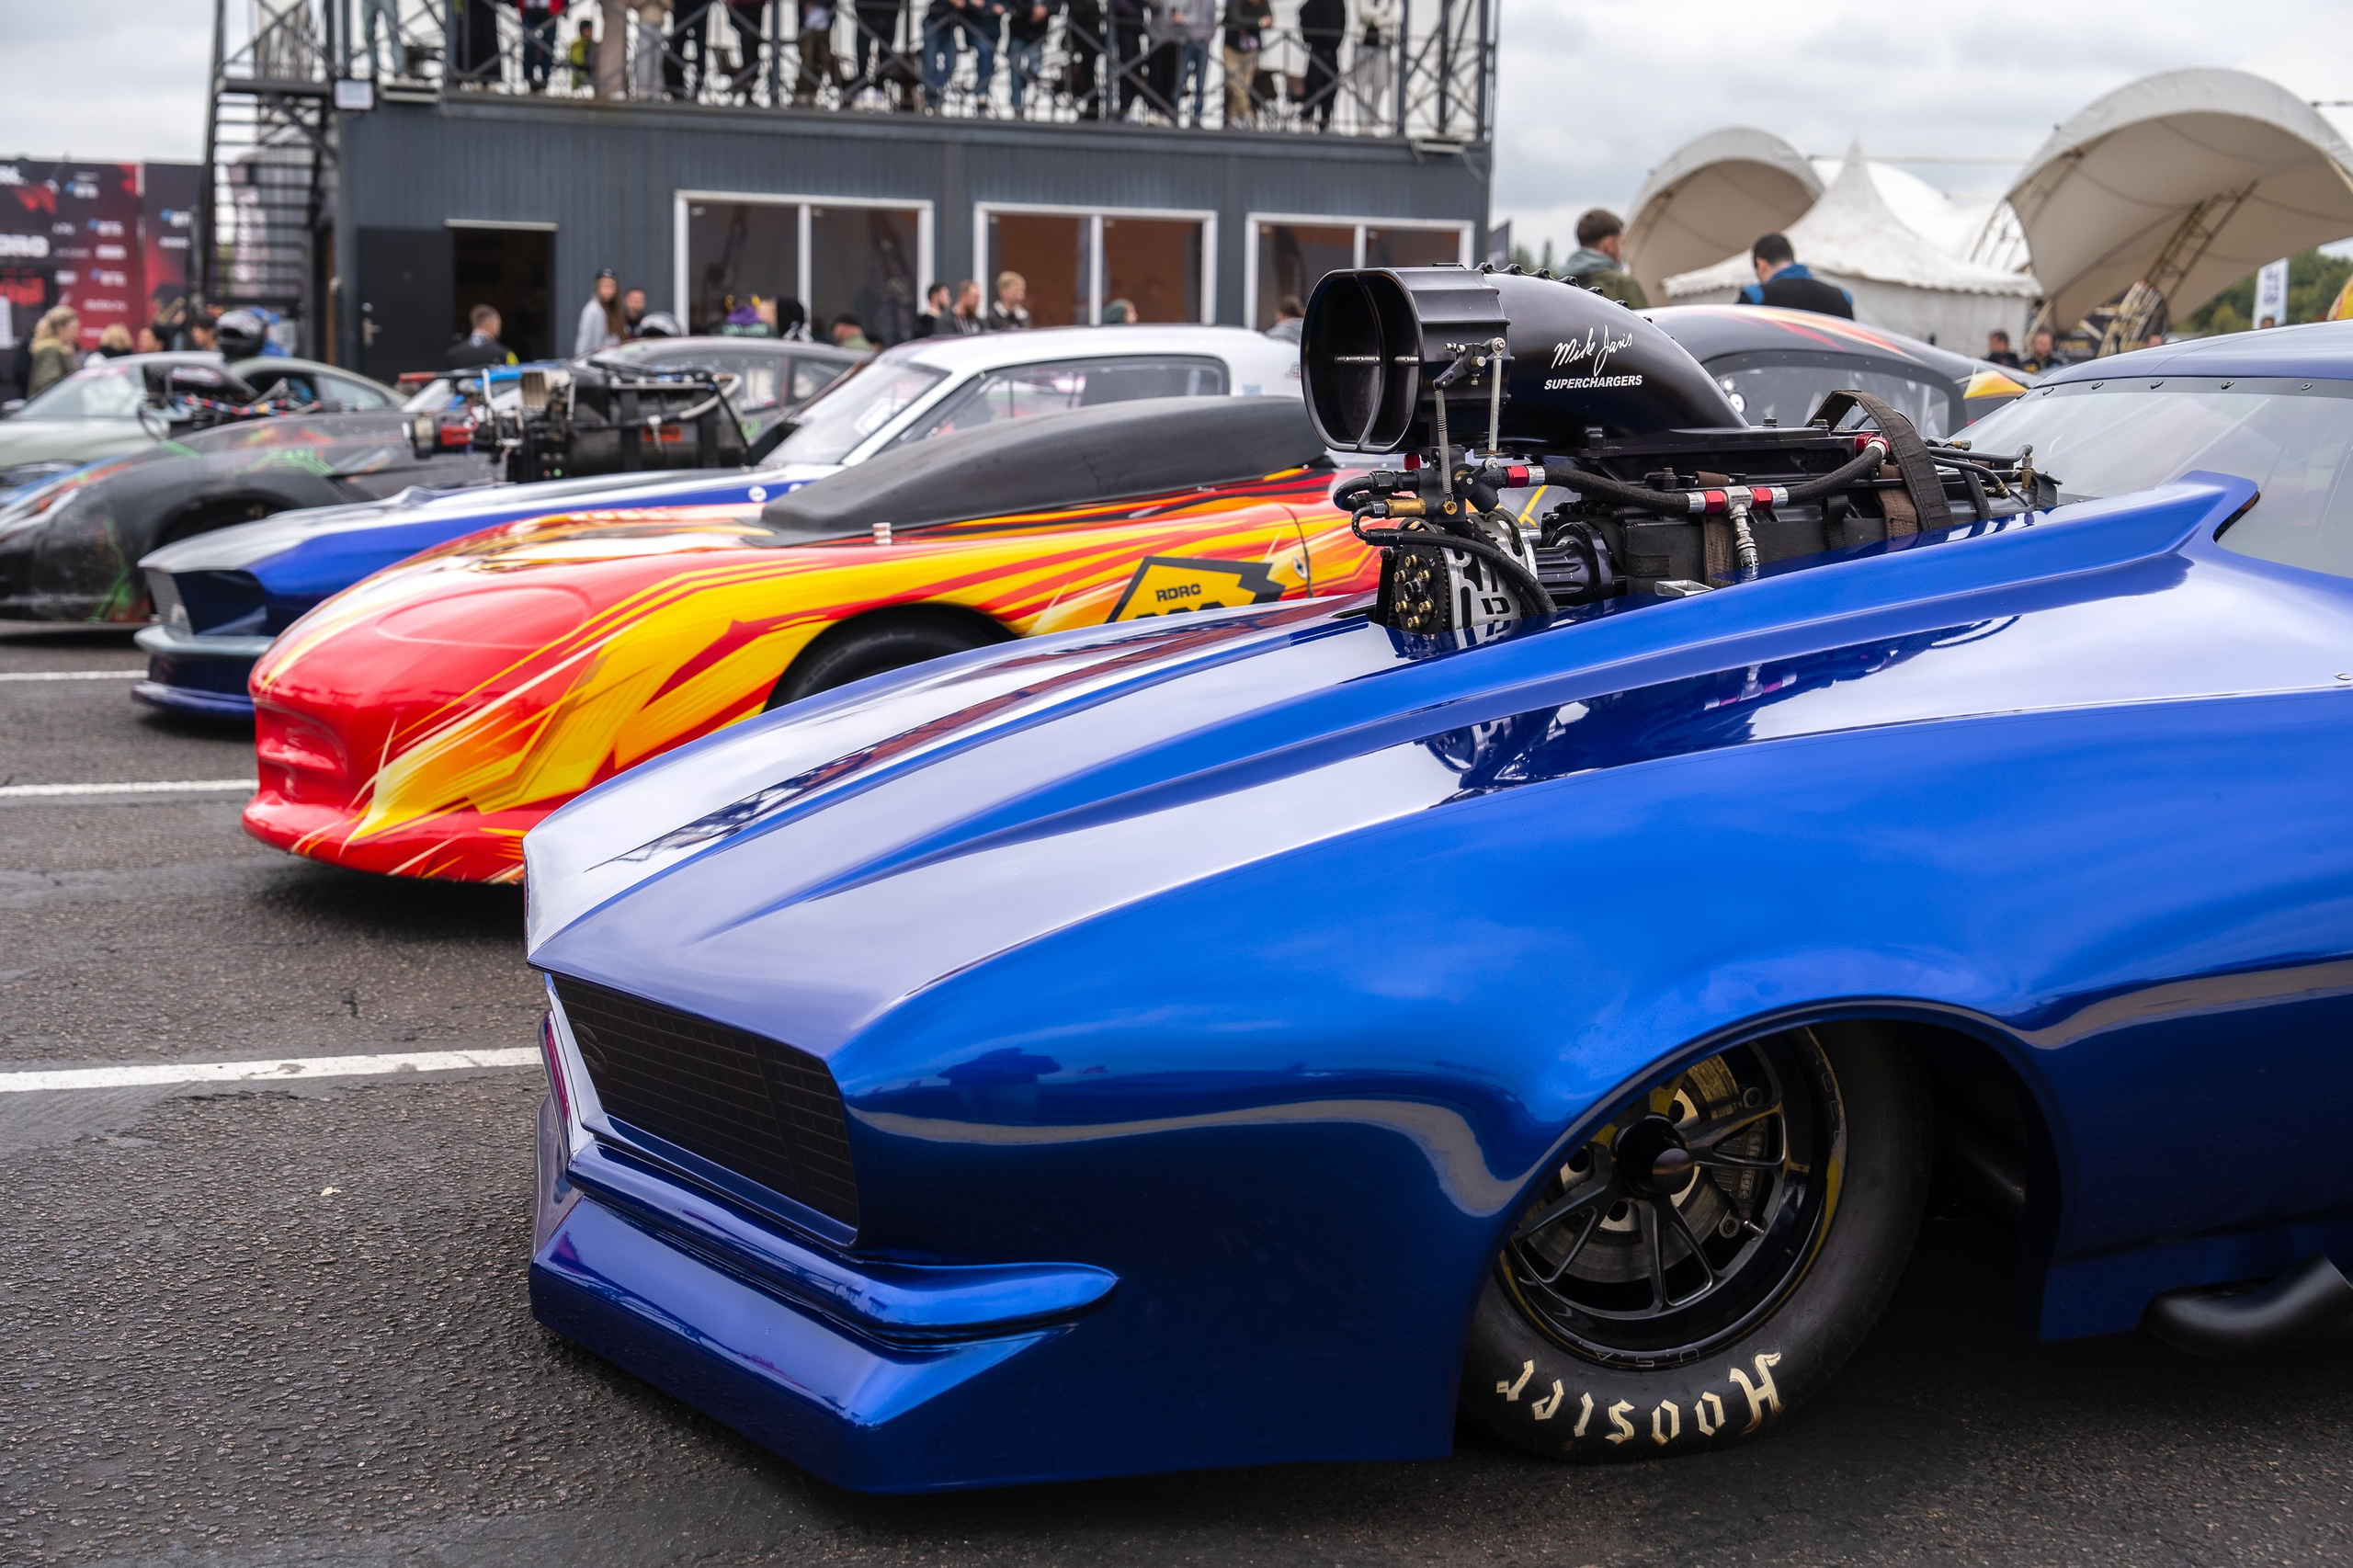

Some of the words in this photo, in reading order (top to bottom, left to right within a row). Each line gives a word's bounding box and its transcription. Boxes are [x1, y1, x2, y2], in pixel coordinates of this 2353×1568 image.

[1551, 327, 1597, 369] Mike
[1544, 374, 1643, 390] SUPERCHARGERS
[1155, 584, 1201, 602] RDRC
[1495, 1351, 1787, 1447] Hoosier
